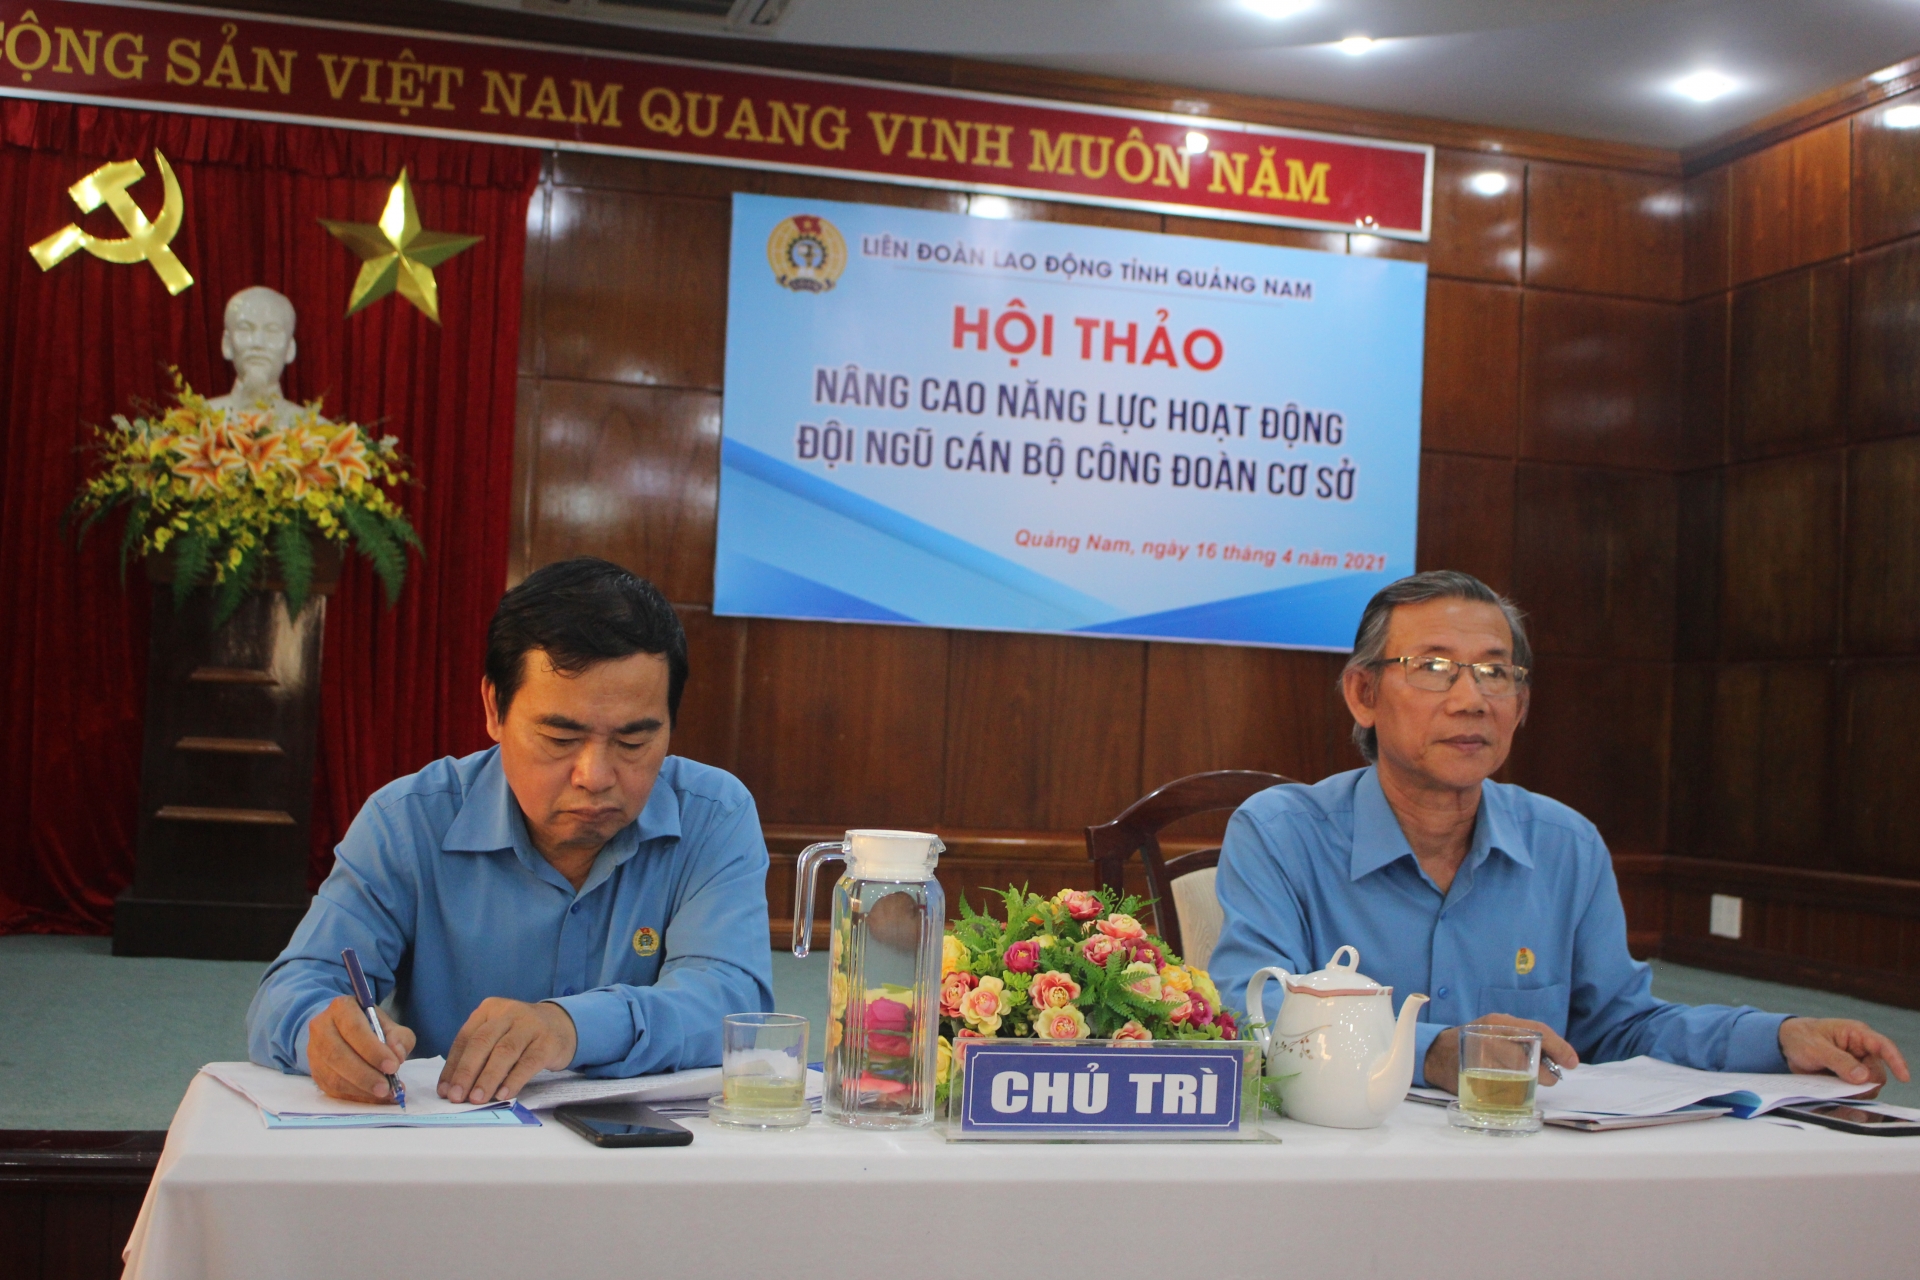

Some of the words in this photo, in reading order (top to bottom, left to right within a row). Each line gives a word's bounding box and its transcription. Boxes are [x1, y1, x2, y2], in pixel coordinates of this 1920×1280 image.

[0, 9, 149, 82] ỘNG
[166, 24, 297, 94] SẢN
[318, 49, 463, 117] VIỆT
[480, 71, 622, 127] NAM
[639, 87, 851, 151] QUANG
[868, 111, 1012, 170] VINH
[1029, 126, 1191, 189] MUÔN
[1208, 144, 1330, 205] NĂM
[863, 234, 908, 258] LIÊN
[917, 240, 984, 265] ĐOÀN
[994, 252, 1036, 270] LAO
[1045, 253, 1112, 280] ĐỘNG
[1177, 266, 1256, 294] QUẢNG
[1264, 279, 1312, 299] NAM
[953, 298, 1054, 367] HỘI
[1074, 308, 1223, 371] THẢO
[815, 364, 909, 409] NÂNG
[921, 378, 986, 415] CAO
[997, 379, 1086, 423] NĂNG
[1099, 392, 1157, 434] LỰC
[1168, 399, 1251, 442] HOẠT
[1260, 403, 1343, 448] ĐỘNG
[797, 420, 853, 468] ĐỘI
[865, 427, 933, 467] NGŨ
[945, 432, 1010, 473] CÁN
[1022, 437, 1064, 484] BỘ
[1076, 442, 1161, 484] CÔNG
[1172, 451, 1257, 492] ĐOÀN
[1268, 463, 1308, 496] CƠ
[1316, 457, 1356, 500] SỞ
[1015, 529, 1080, 554] Quảng
[1086, 534, 1135, 556] Nam,
[1142, 539, 1189, 561] ngày
[1197, 543, 1217, 559] 16
[1222, 545, 1276, 568] tháng
[1282, 549, 1293, 564] 4
[1297, 550, 1338, 568] năm
[1343, 552, 1386, 571] 2021
[991, 1062, 1109, 1115] CHỦ
[1128, 1067, 1218, 1114] TRÌ
